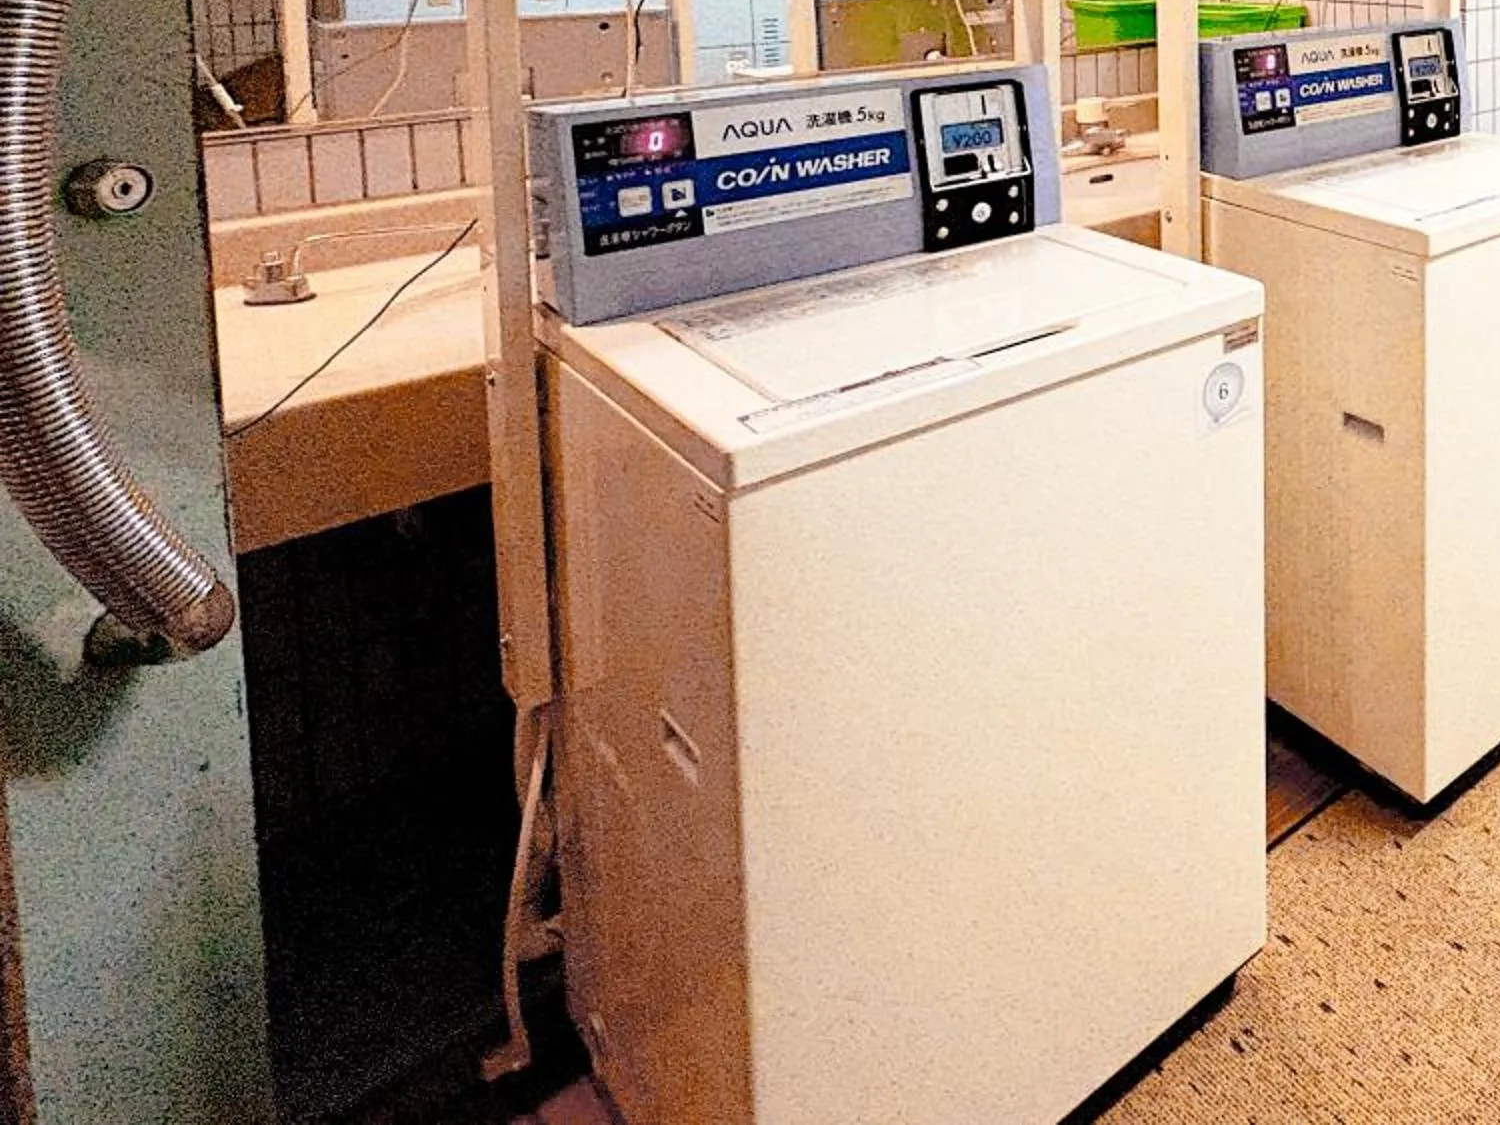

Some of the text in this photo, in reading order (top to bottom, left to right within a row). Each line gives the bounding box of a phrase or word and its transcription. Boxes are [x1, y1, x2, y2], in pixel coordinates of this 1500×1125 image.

[1301, 50, 1335, 64] AQUA
[1300, 73, 1384, 98] COIN WASHER
[722, 106, 885, 141] AQUA 洗濯機 5kg
[716, 147, 891, 190] COIN WASHER
